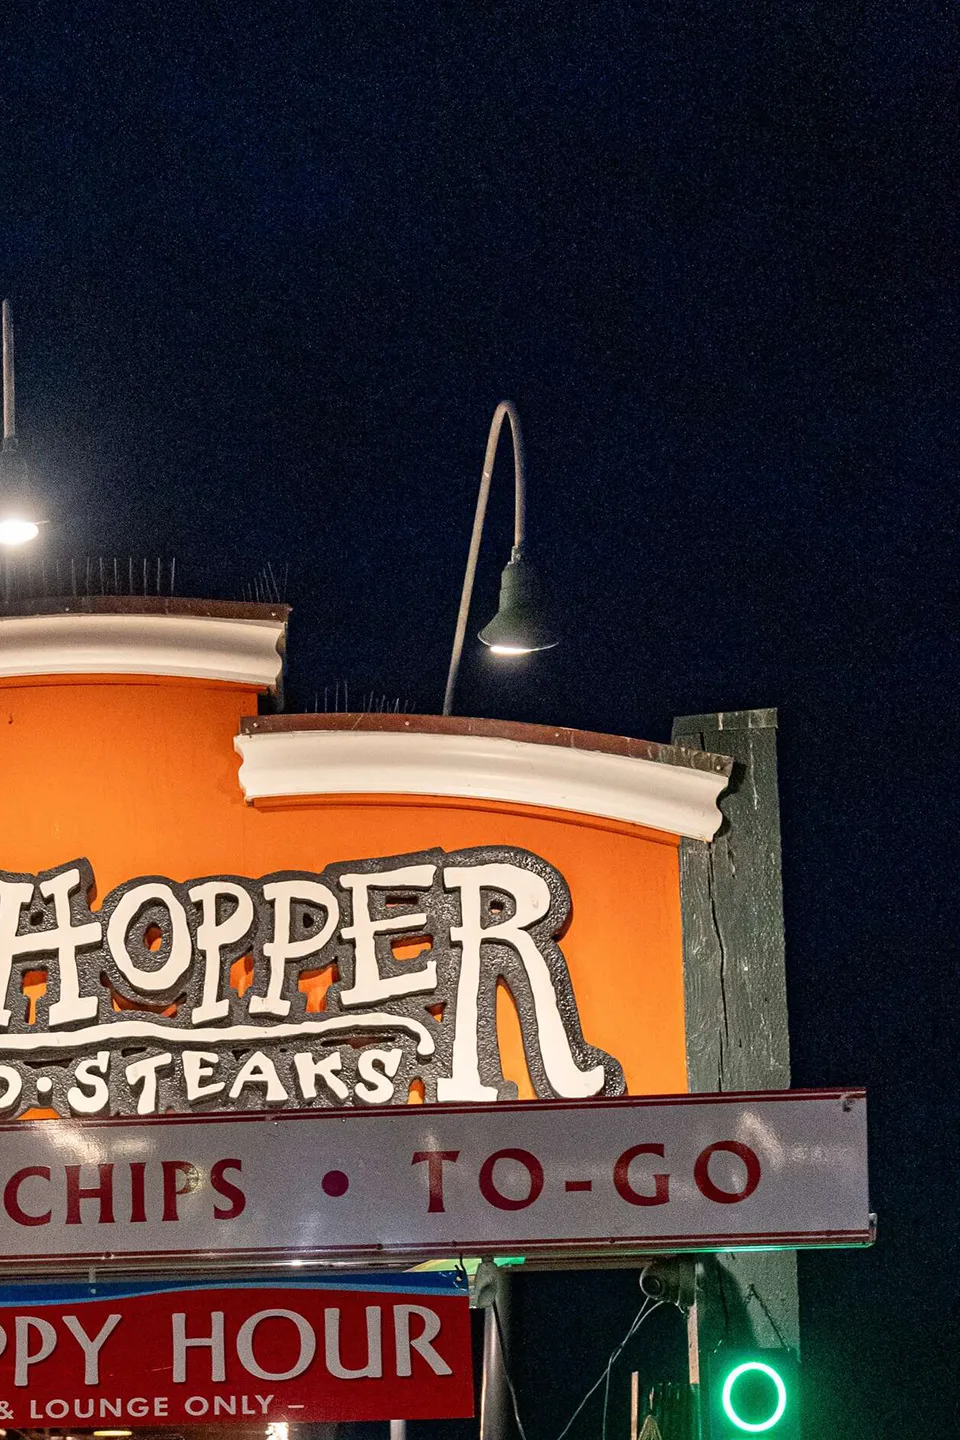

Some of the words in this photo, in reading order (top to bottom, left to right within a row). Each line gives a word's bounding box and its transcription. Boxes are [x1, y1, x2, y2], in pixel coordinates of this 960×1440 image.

[68, 1048, 403, 1115] STEAKS
[3, 1158, 247, 1227] CHIPS
[411, 1140, 761, 1214] TO-GO
[171, 1303, 453, 1384] HOUR
[30, 1397, 169, 1420] LOUNGE
[185, 1394, 275, 1416] ONLY
